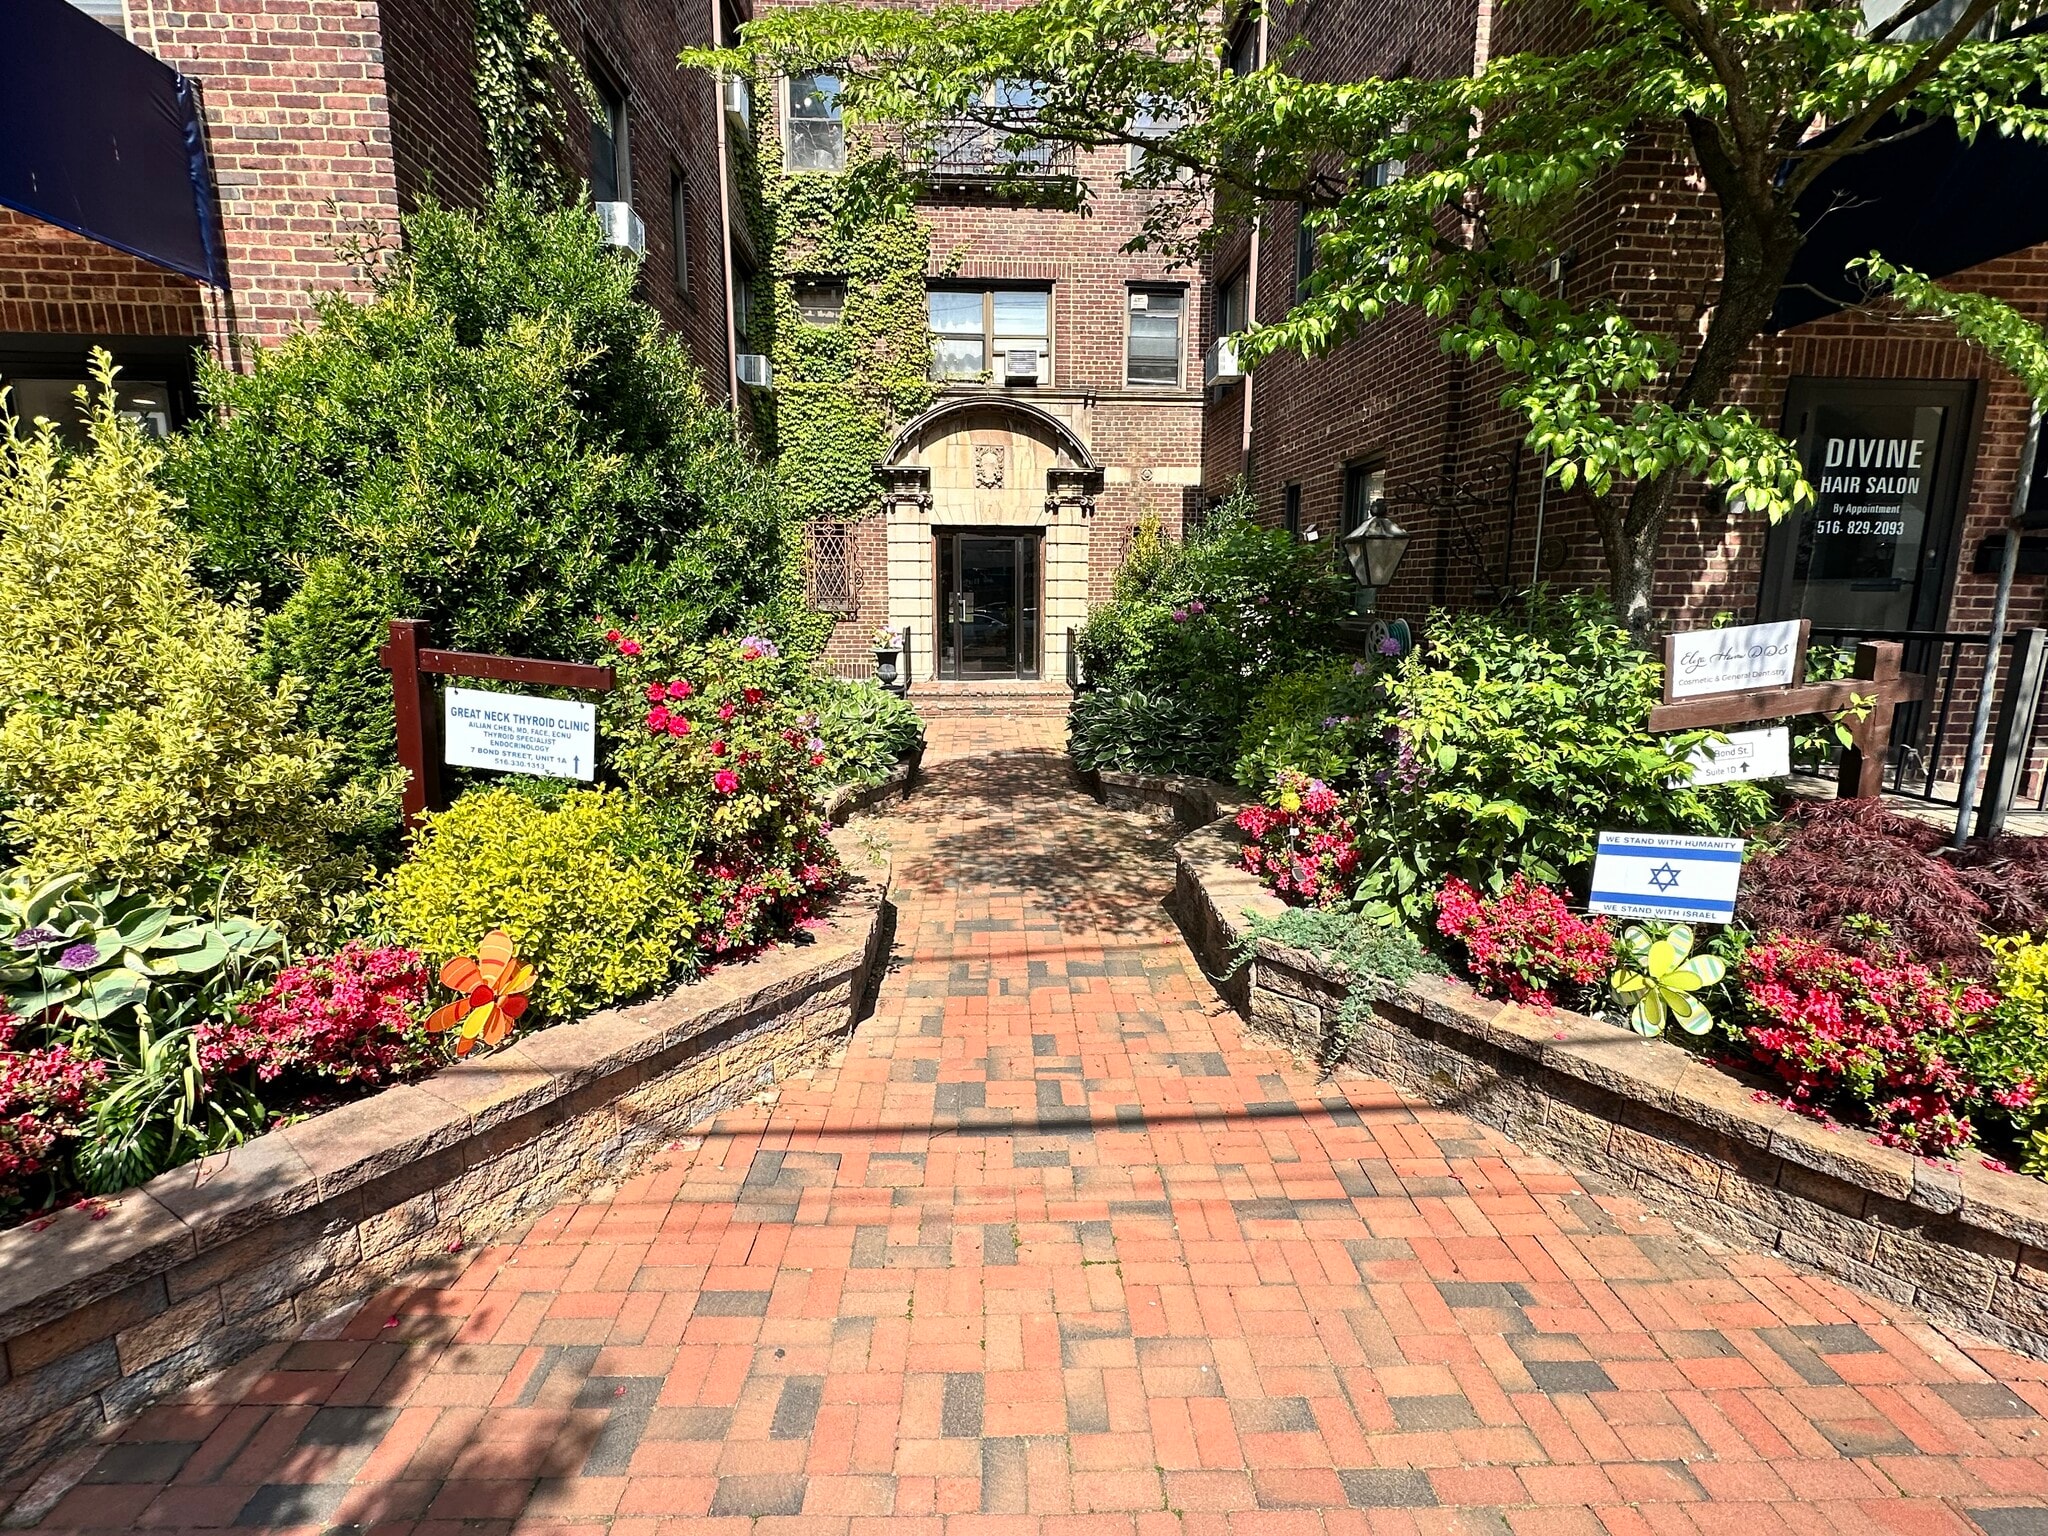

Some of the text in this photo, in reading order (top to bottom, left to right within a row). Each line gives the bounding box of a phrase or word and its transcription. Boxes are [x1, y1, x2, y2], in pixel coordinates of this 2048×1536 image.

[1825, 438, 1925, 469] DIVINE
[1820, 476, 1920, 494] HAIR SALON
[1833, 503, 1901, 516] By Appointment
[1678, 677, 1713, 686] Cosmetic
[1721, 671, 1751, 681] General
[1752, 668, 1786, 678] Dentistry
[450, 706, 590, 732] GREAT NECK THYROID CLINIC
[468, 721, 492, 730] AILIAN
[483, 731, 556, 745] THYROID SPECIALIST
[490, 740, 550, 752] ENDOCRINOLOGY
[1714, 746, 1749, 758] Bond St.
[477, 747, 499, 756] BOND
[502, 751, 533, 760] STREET,
[535, 754, 554, 762] UNIT
[1706, 766, 1736, 777] Suite 1D
[1605, 836, 1736, 849] WE STAND WITH HUMANITY
[1621, 905, 1652, 914] STAND
[1655, 908, 1680, 917] WITH
[1682, 910, 1717, 920] ISRAEL
